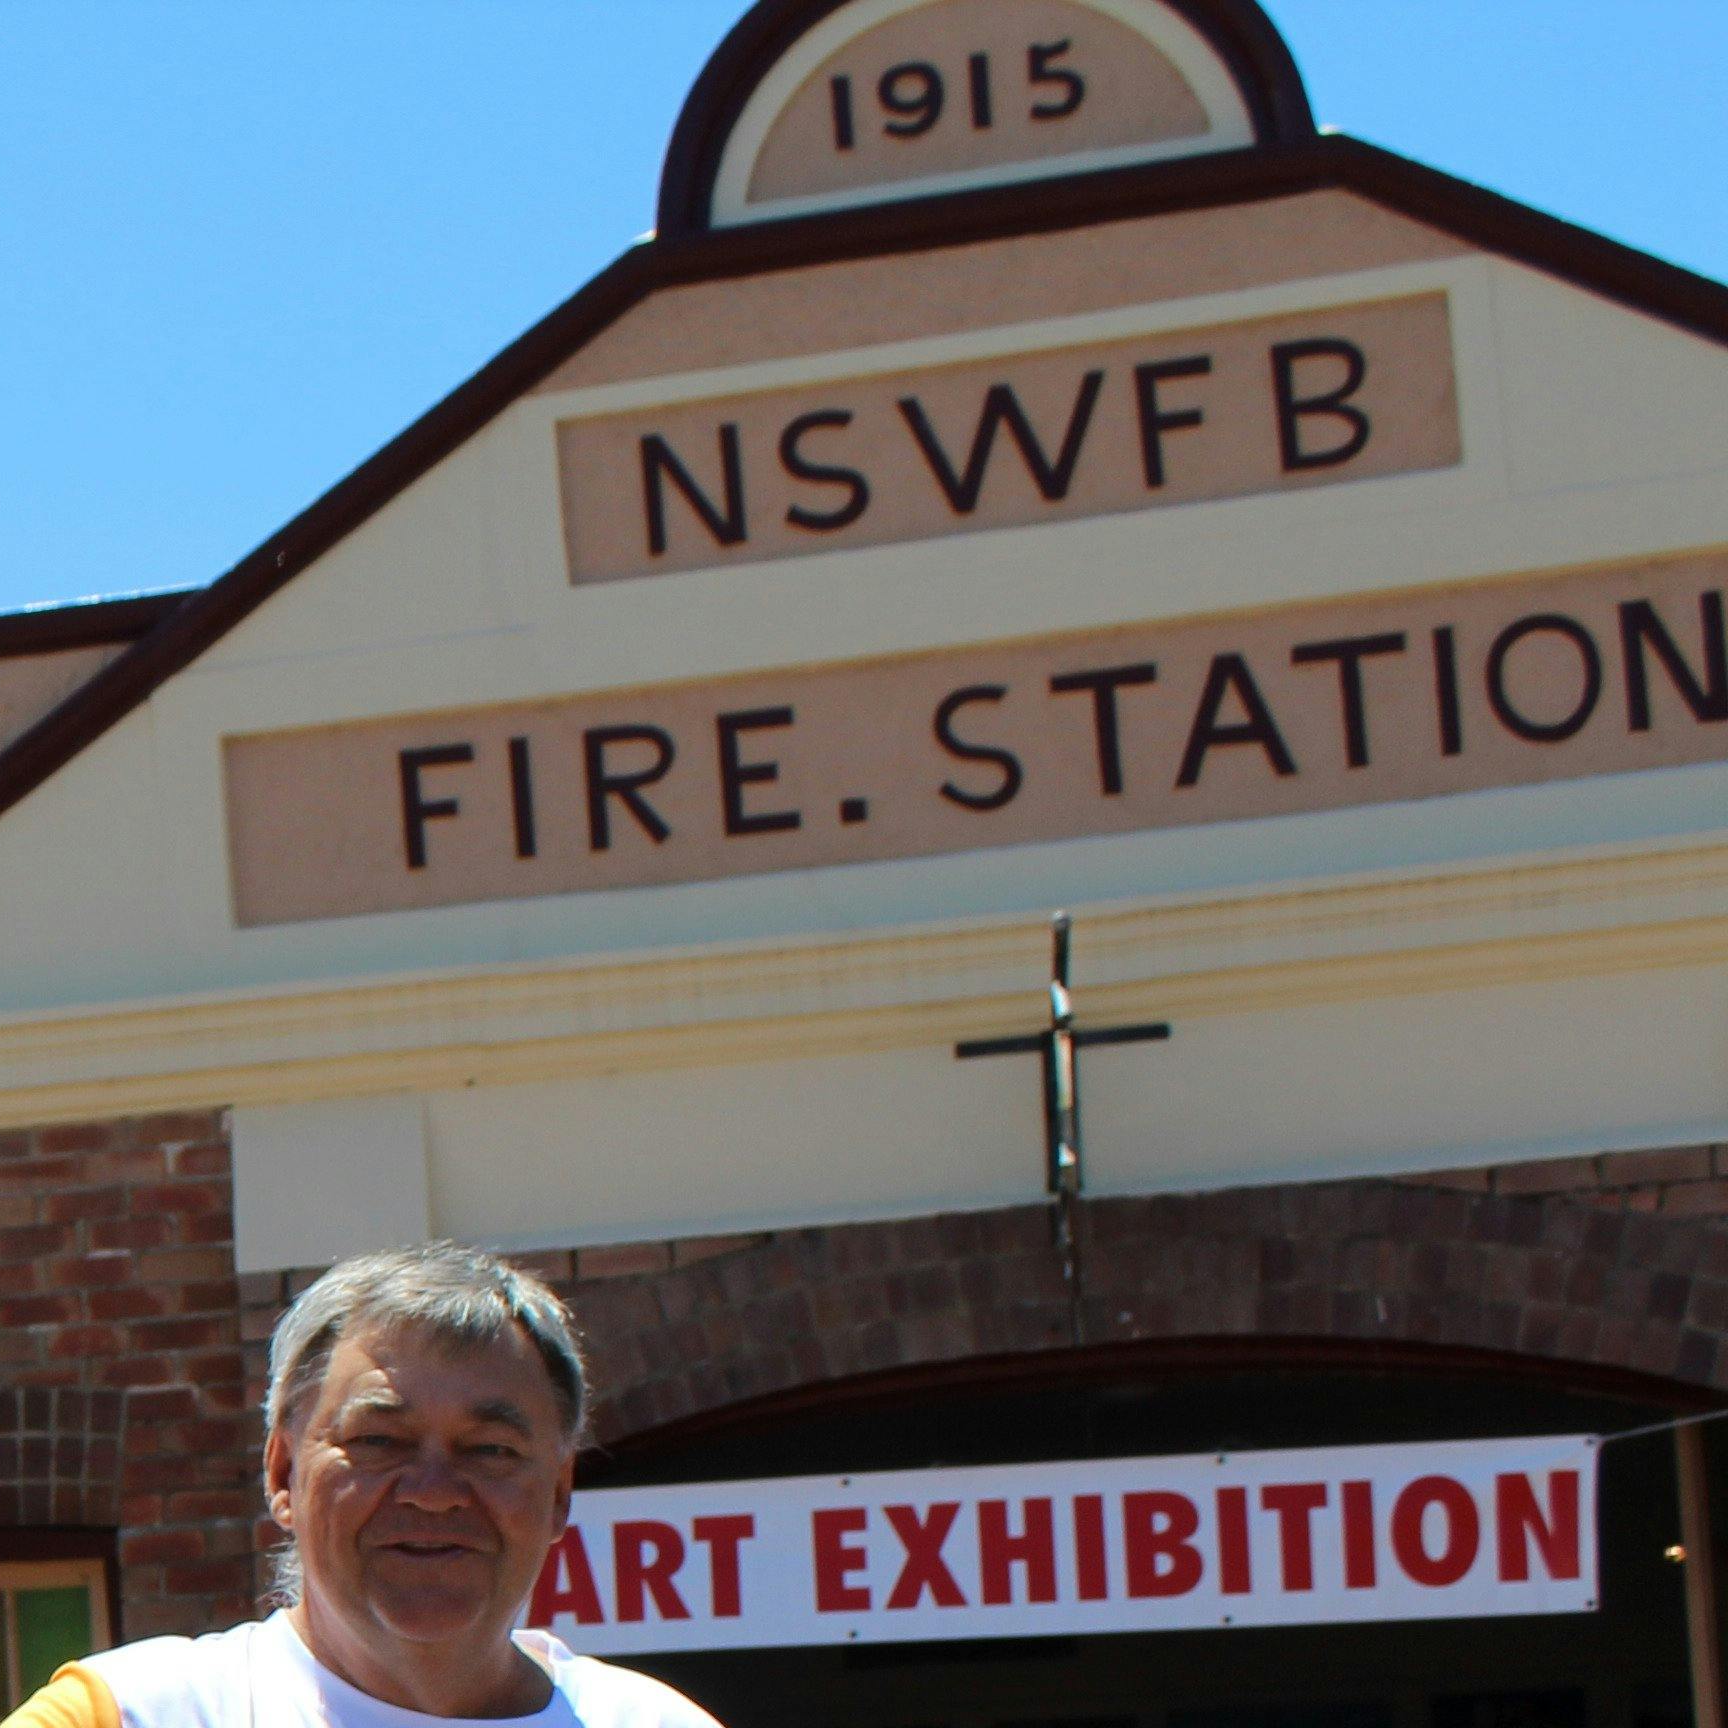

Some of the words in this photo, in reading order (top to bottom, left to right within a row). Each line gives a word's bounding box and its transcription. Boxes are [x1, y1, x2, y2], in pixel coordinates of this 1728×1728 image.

[829, 38, 1087, 152] 1915
[638, 336, 1372, 560] NSWFB
[932, 589, 1728, 813] STATION
[527, 1514, 755, 1628] ART
[813, 1470, 1580, 1613] EXHIBITION
